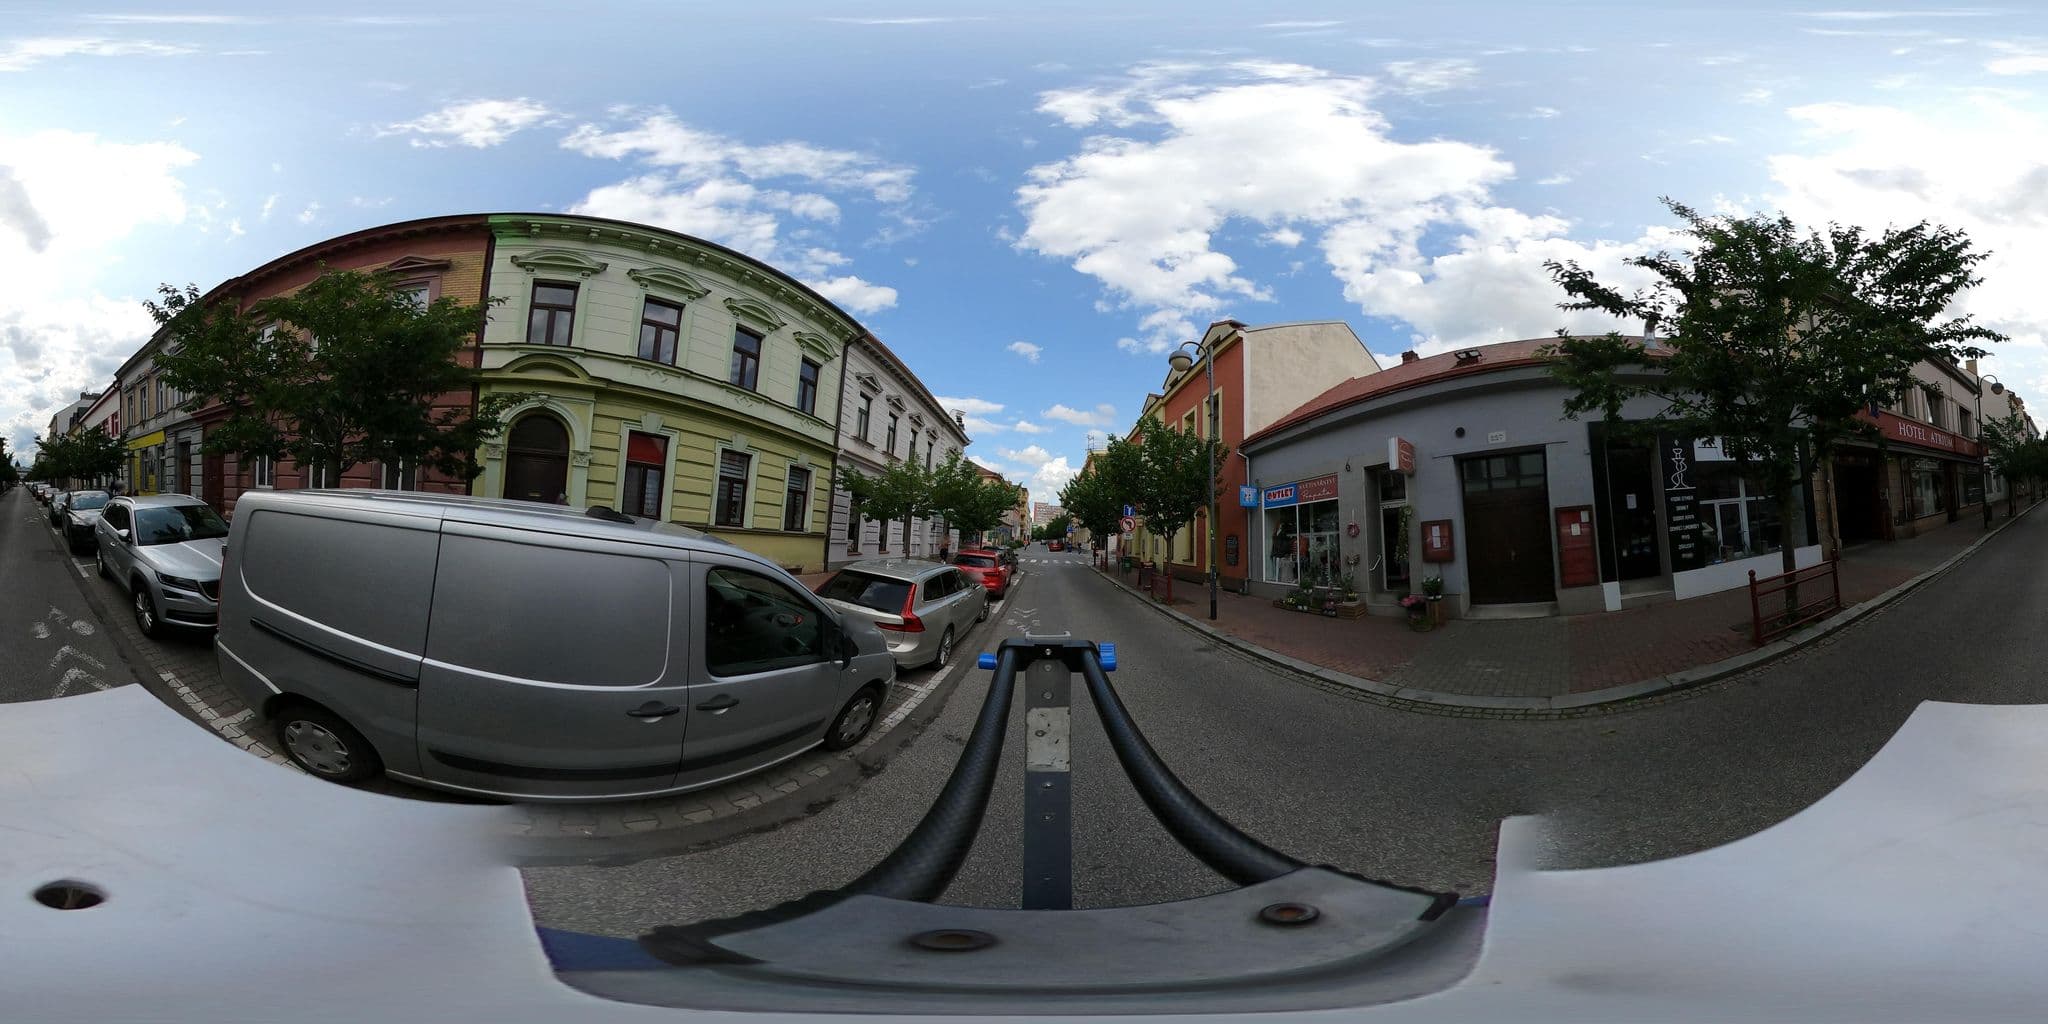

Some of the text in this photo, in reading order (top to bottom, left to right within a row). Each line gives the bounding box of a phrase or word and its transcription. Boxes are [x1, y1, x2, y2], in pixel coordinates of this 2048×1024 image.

[1898, 422, 1954, 448] HOTEL ATRIUM
[1266, 488, 1294, 500] OUTLET
